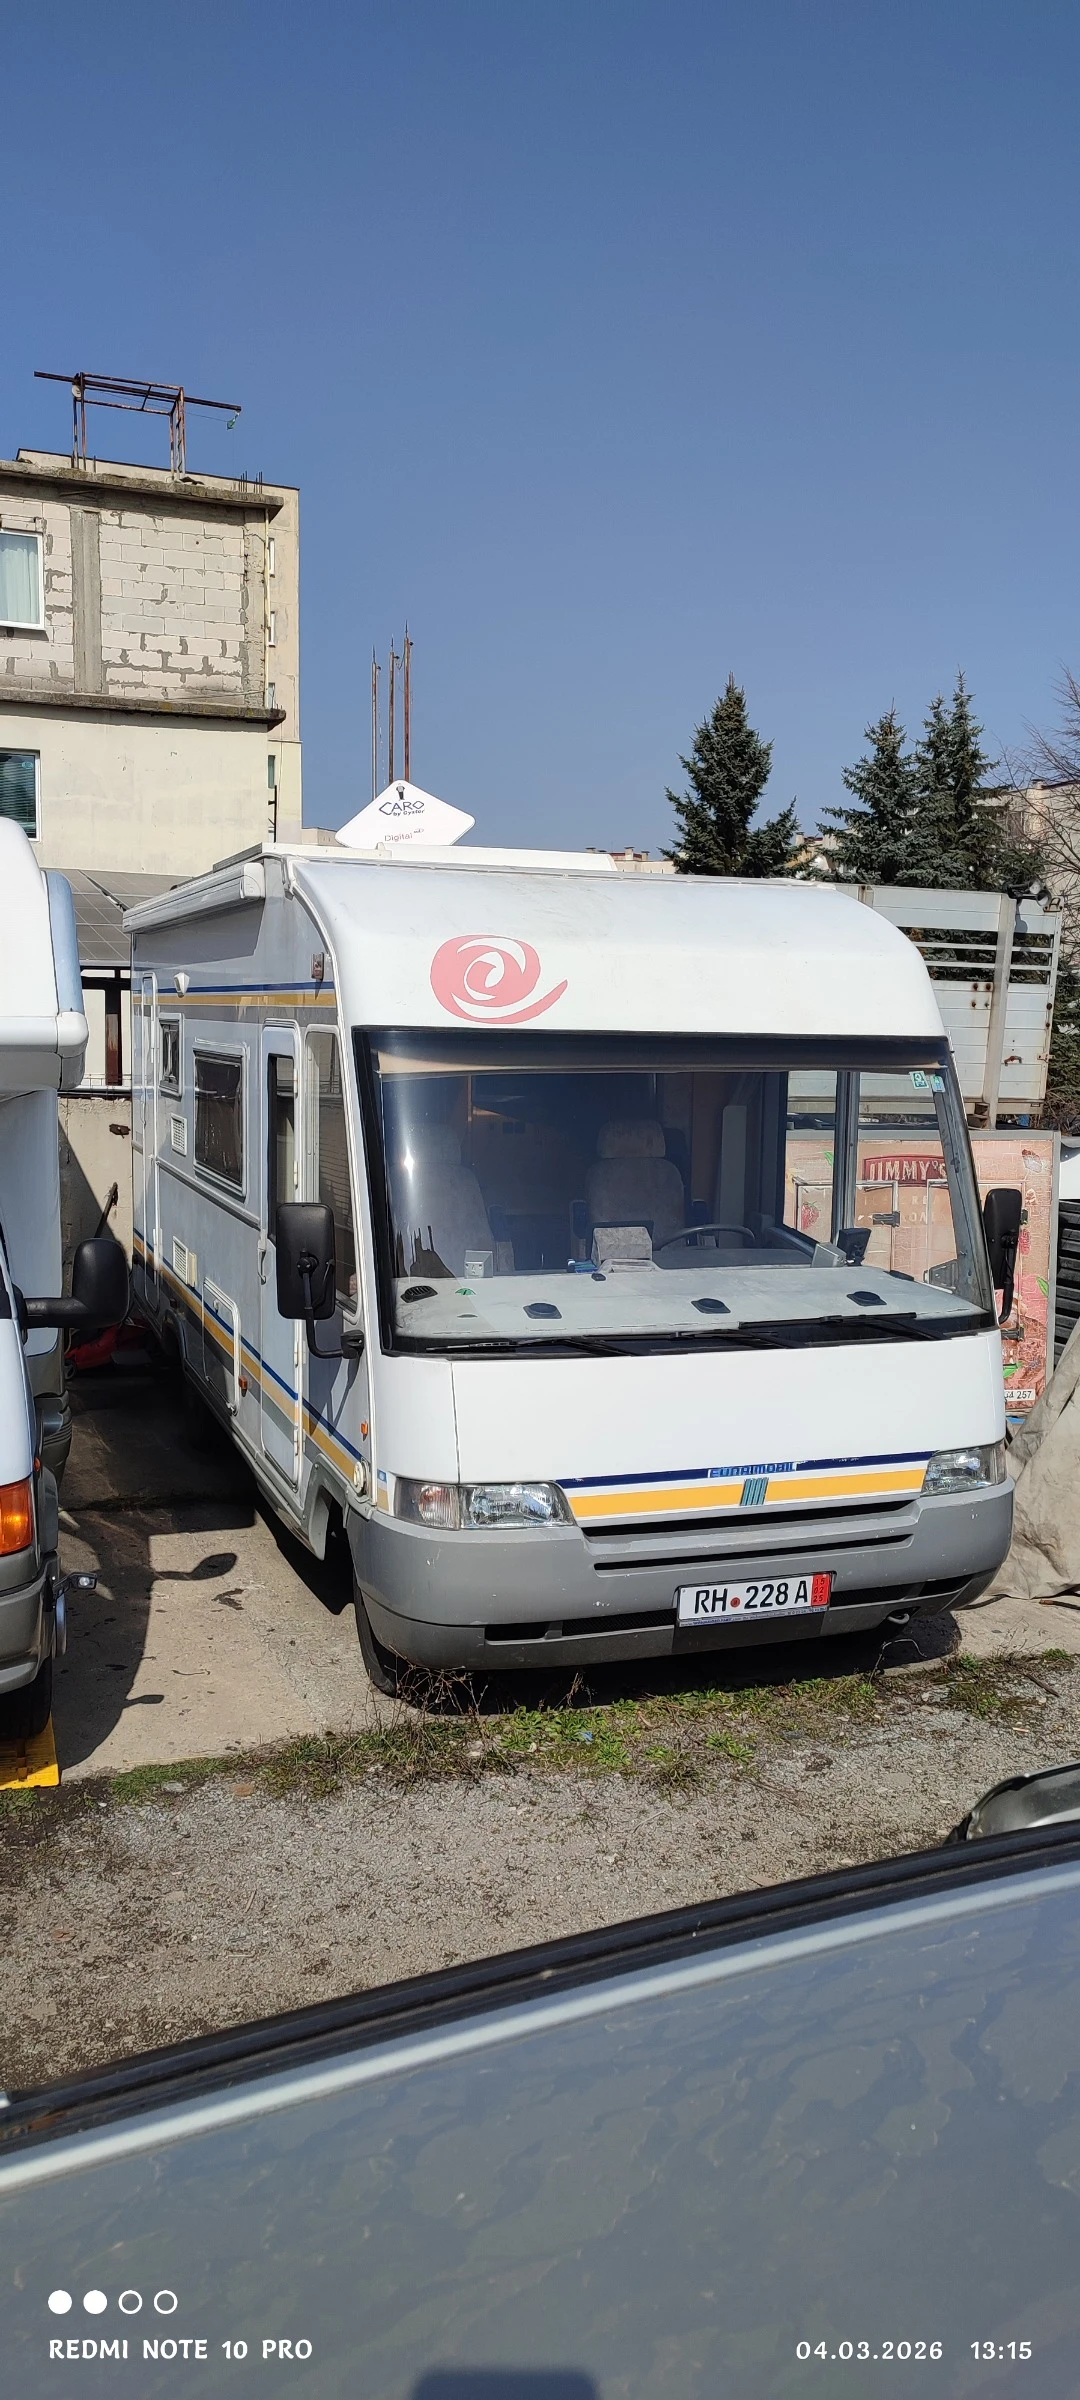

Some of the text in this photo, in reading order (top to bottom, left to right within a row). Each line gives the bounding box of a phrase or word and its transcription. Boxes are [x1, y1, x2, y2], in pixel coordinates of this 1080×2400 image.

[379, 801, 424, 815] CARO
[384, 833, 412, 842] Digital
[1016, 1390, 1032, 1399] 257
[816, 1577, 826, 1586] 15
[814, 1586, 824, 1595] 02
[694, 1580, 808, 1614] RH 228 A
[813, 1595, 824, 1603] 25
